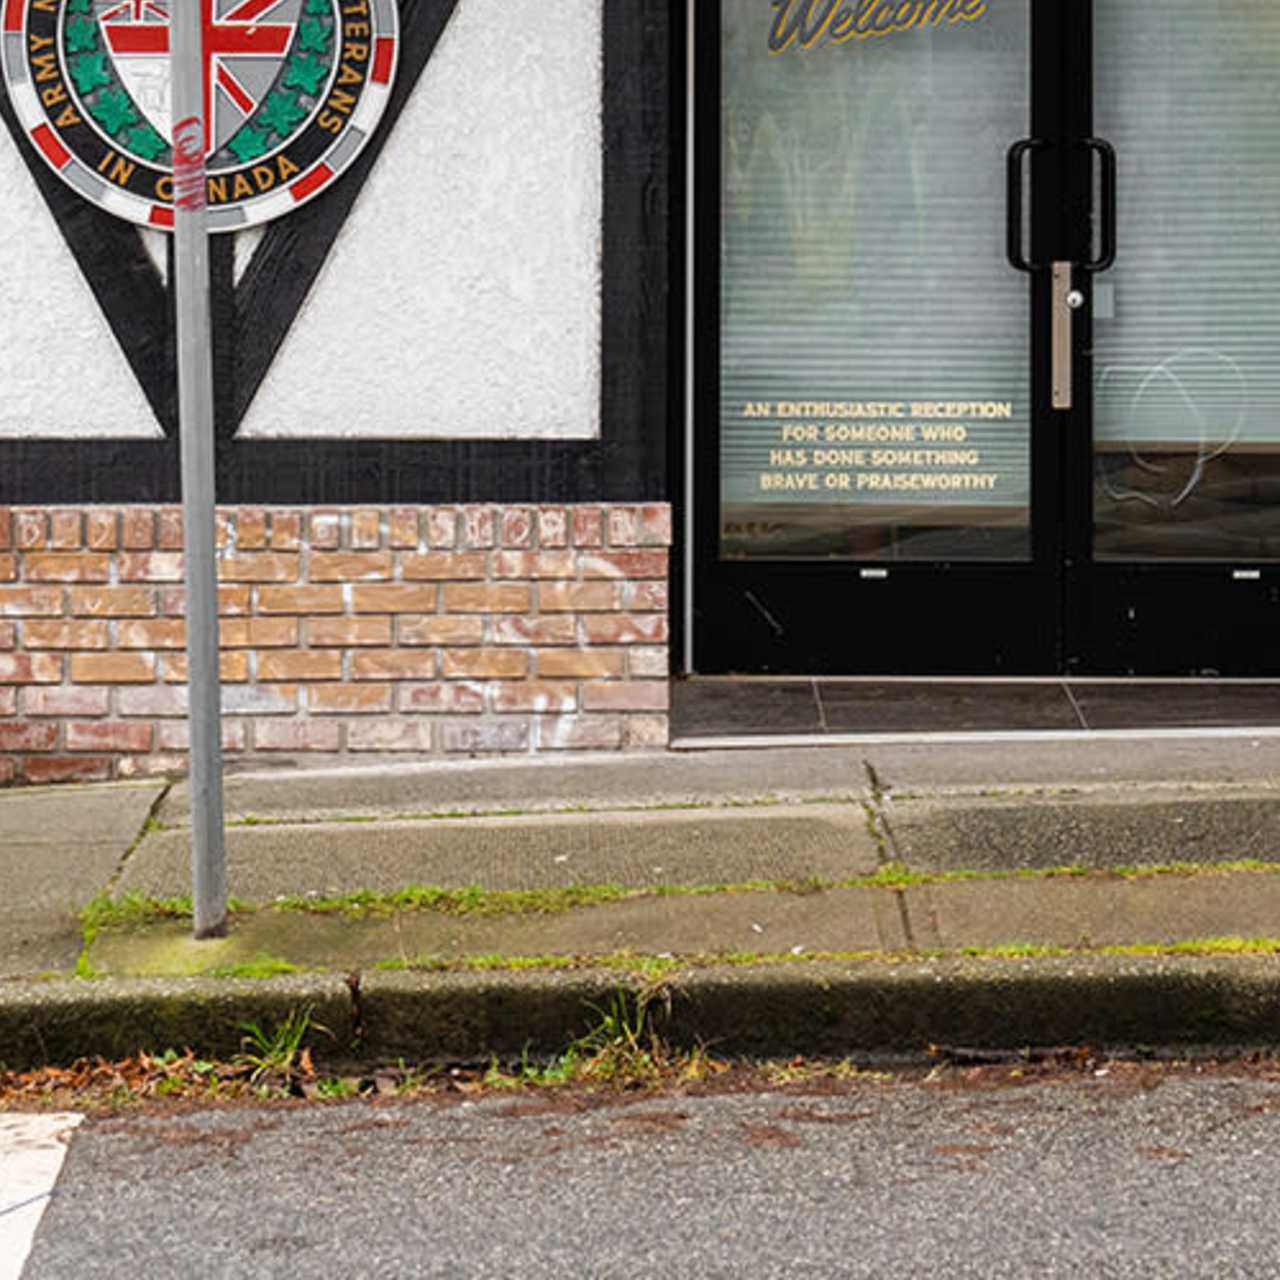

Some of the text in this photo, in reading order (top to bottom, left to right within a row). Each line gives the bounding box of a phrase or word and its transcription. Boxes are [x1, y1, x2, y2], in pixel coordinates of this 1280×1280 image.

[30, 35, 81, 127] ARMY
[96, 150, 300, 203] IN CNADA
[743, 402, 1011, 418] AN ENTHUSIASTIC RECEPTION
[782, 425, 967, 441] FOR SOMEONE WHO
[770, 449, 980, 465] HAS DONE SOMETHING
[760, 473, 998, 489] BRAVE OR PRAISEWORTHY
